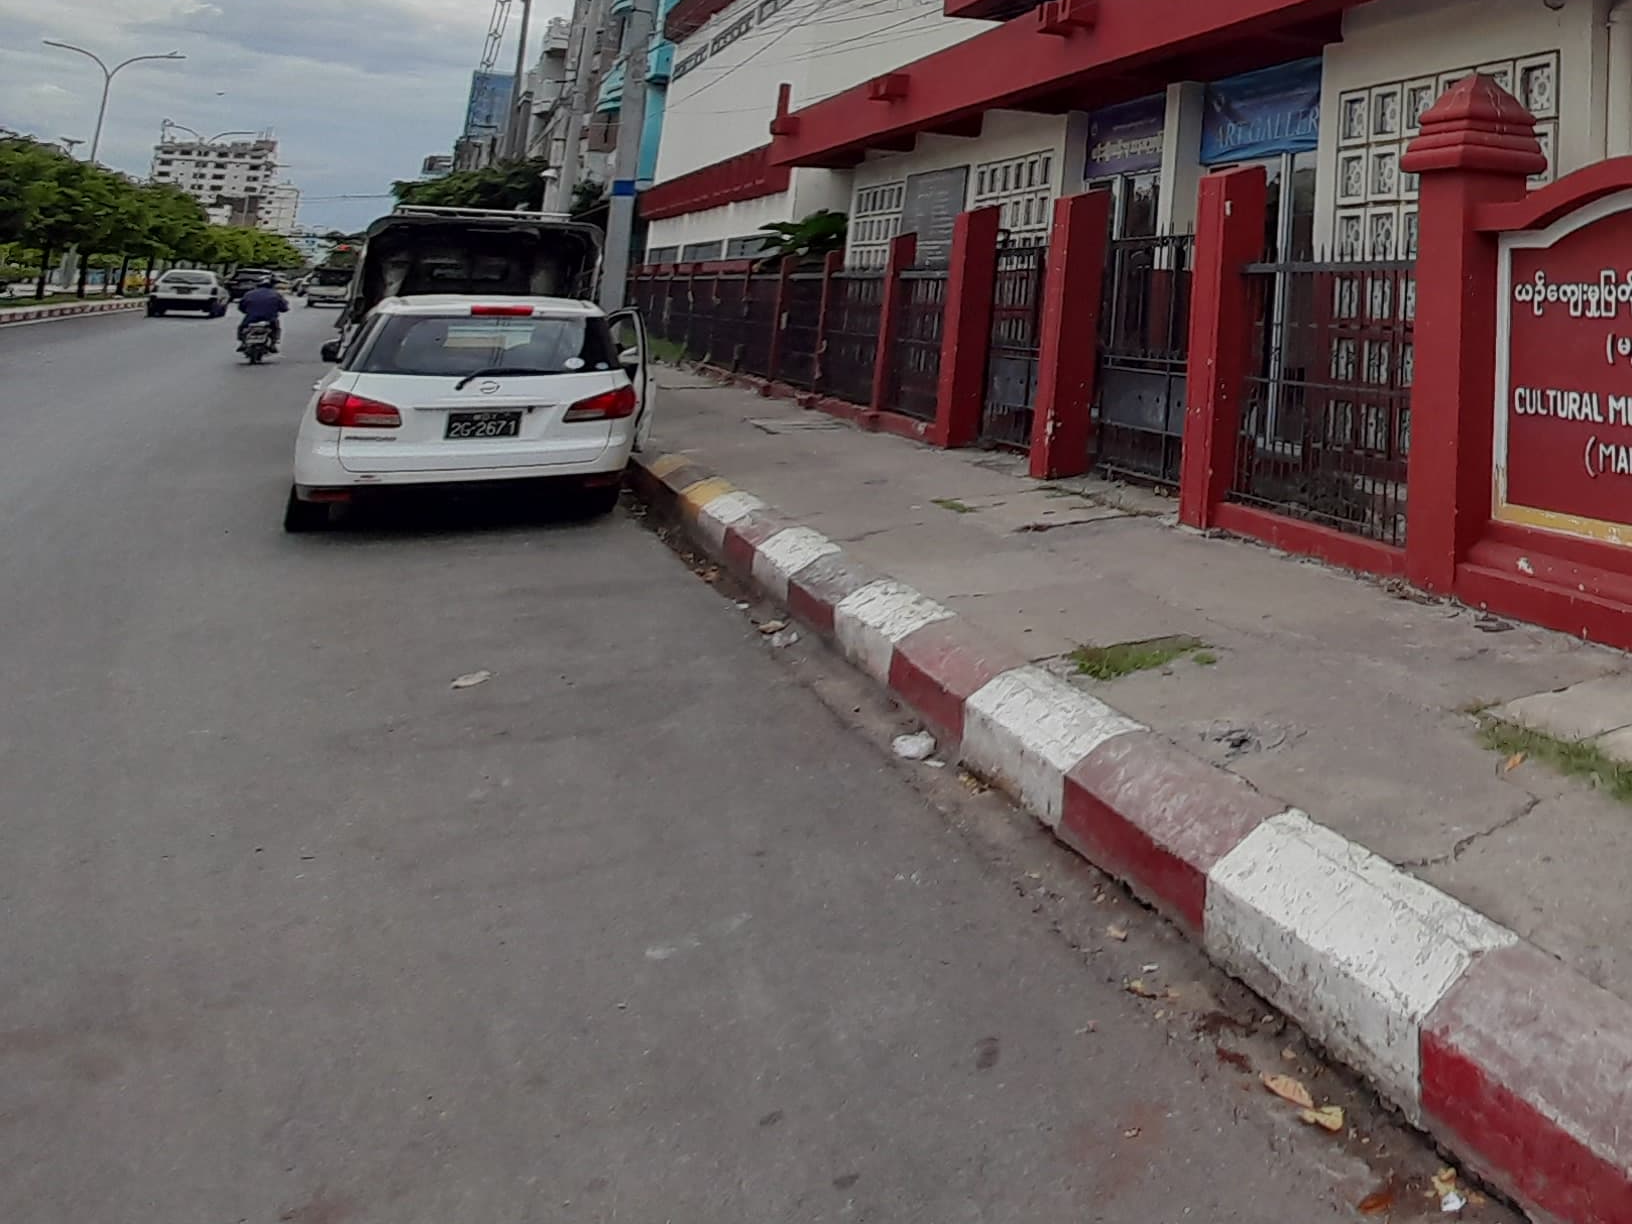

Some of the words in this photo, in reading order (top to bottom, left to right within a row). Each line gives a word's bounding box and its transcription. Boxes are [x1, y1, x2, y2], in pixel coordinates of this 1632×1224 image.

[1249, 105, 1319, 142] GALLER
[1514, 387, 1604, 423] CULTURAL
[449, 420, 517, 438] 2G-2671
